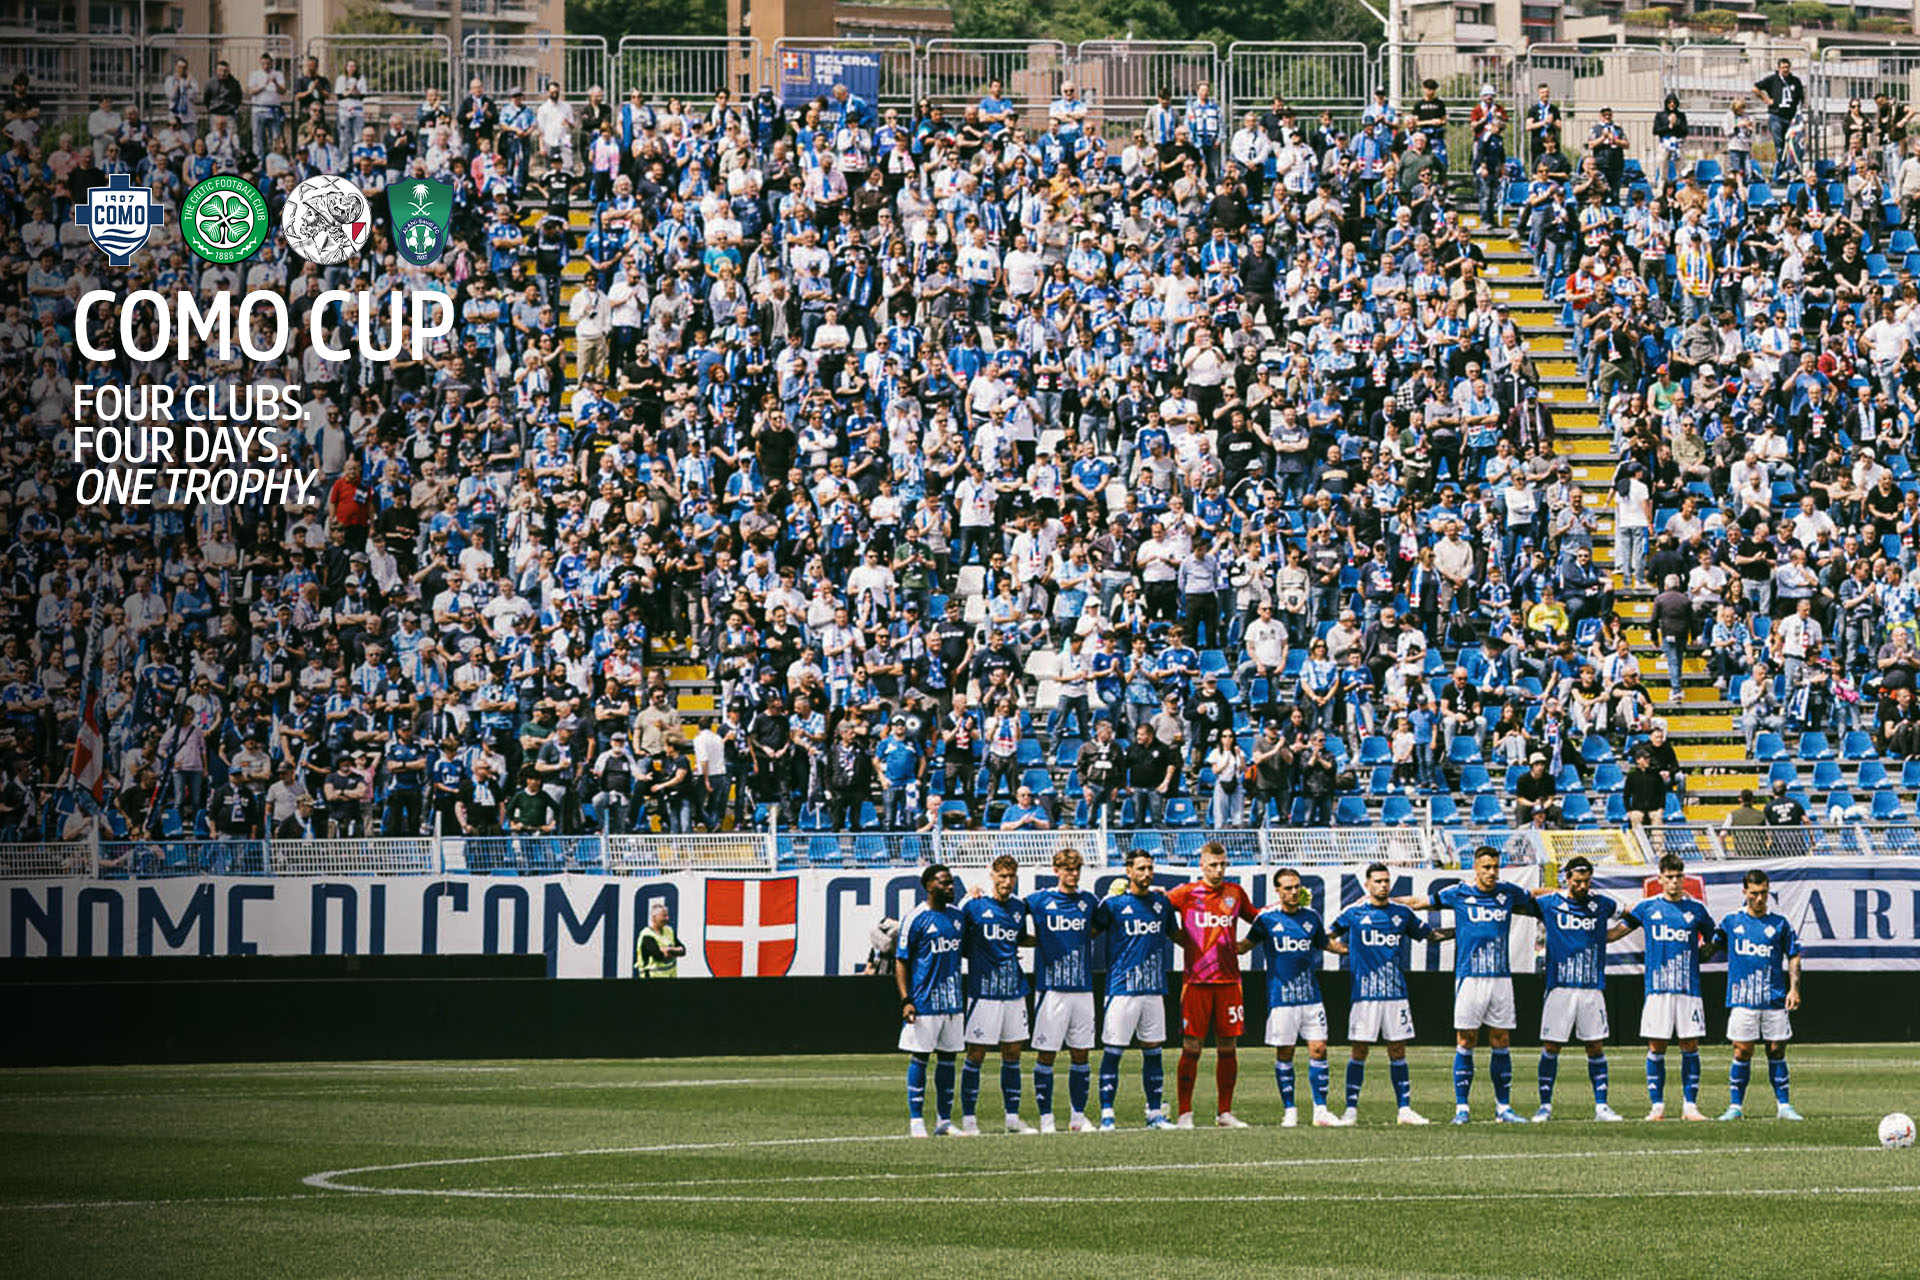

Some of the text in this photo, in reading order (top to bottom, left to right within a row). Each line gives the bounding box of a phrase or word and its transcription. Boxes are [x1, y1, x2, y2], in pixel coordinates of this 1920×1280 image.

[1195, 912, 1234, 928] Uber
[1467, 906, 1508, 922] Uber
[1557, 913, 1598, 930] Uber
[984, 920, 1019, 941] Uber
[1046, 915, 1086, 931] Uber
[1125, 919, 1162, 936] Uber
[1361, 930, 1401, 947] Uber
[1652, 922, 1692, 942] Uber
[931, 937, 961, 954] Uber
[1273, 936, 1312, 952] Uber
[1734, 936, 1774, 957] Uber
[1228, 1006, 1245, 1024] 30
